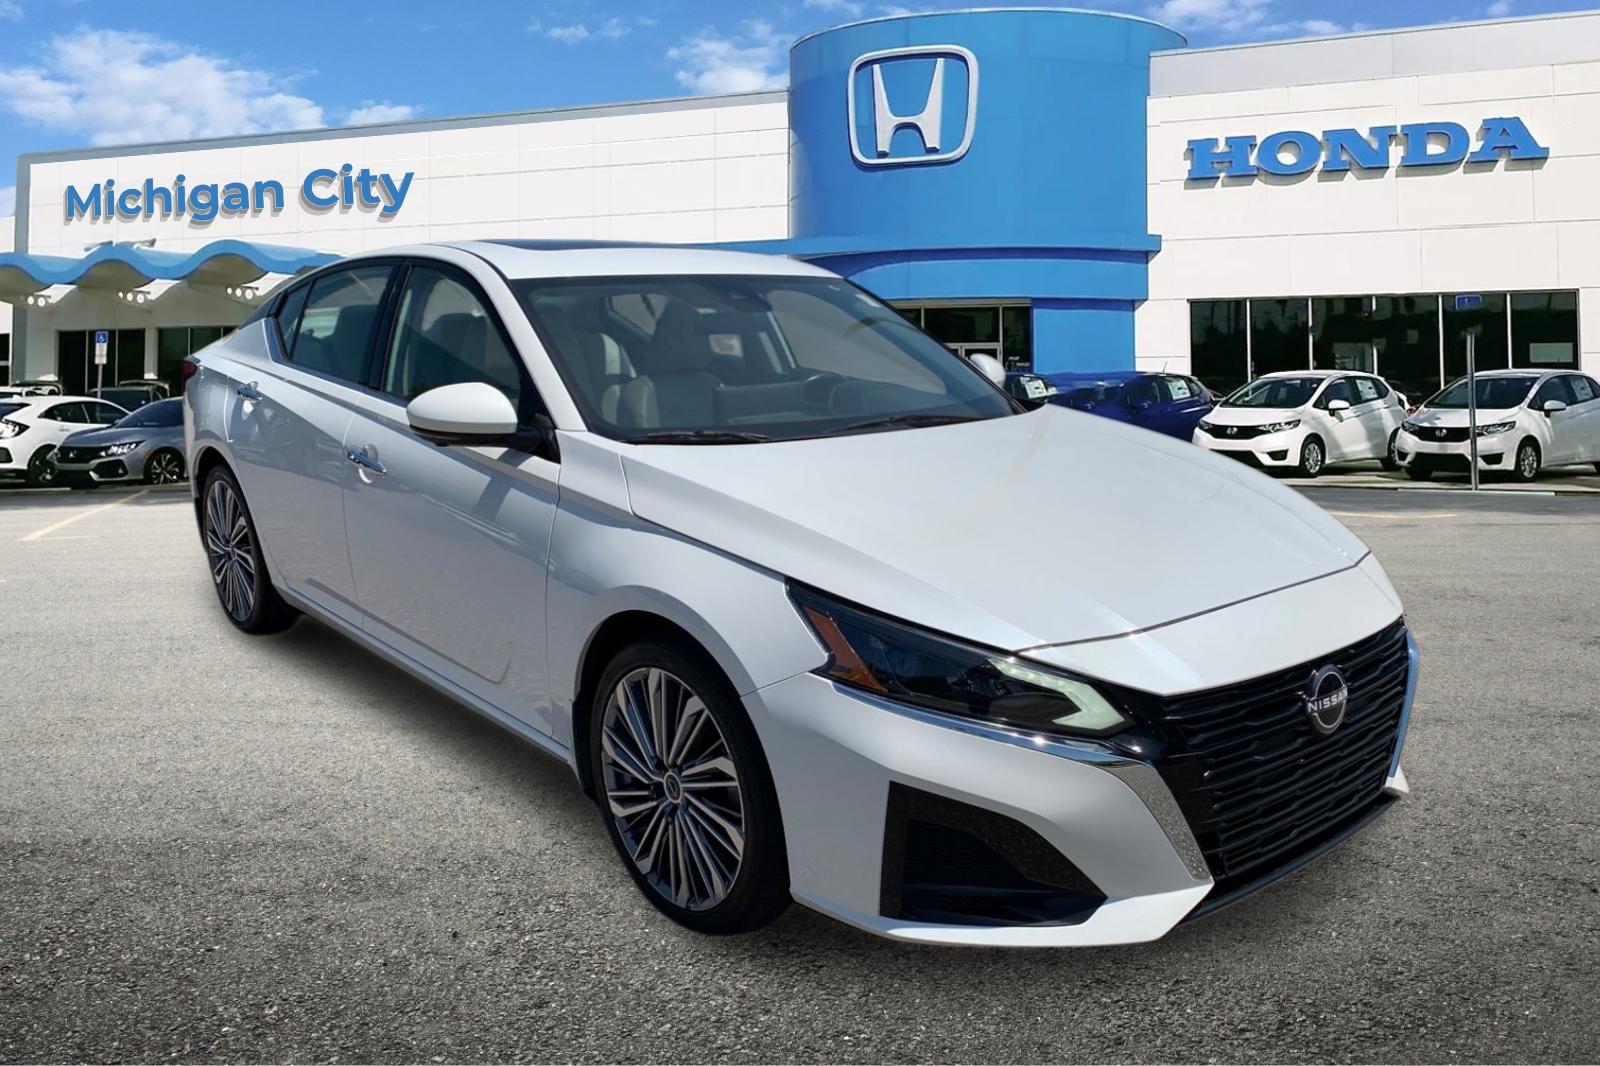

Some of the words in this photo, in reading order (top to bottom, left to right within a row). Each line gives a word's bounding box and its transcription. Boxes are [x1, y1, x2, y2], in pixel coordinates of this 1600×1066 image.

[1187, 117, 1549, 180] HONDA
[66, 174, 284, 222] Michigan
[302, 163, 414, 213] City
